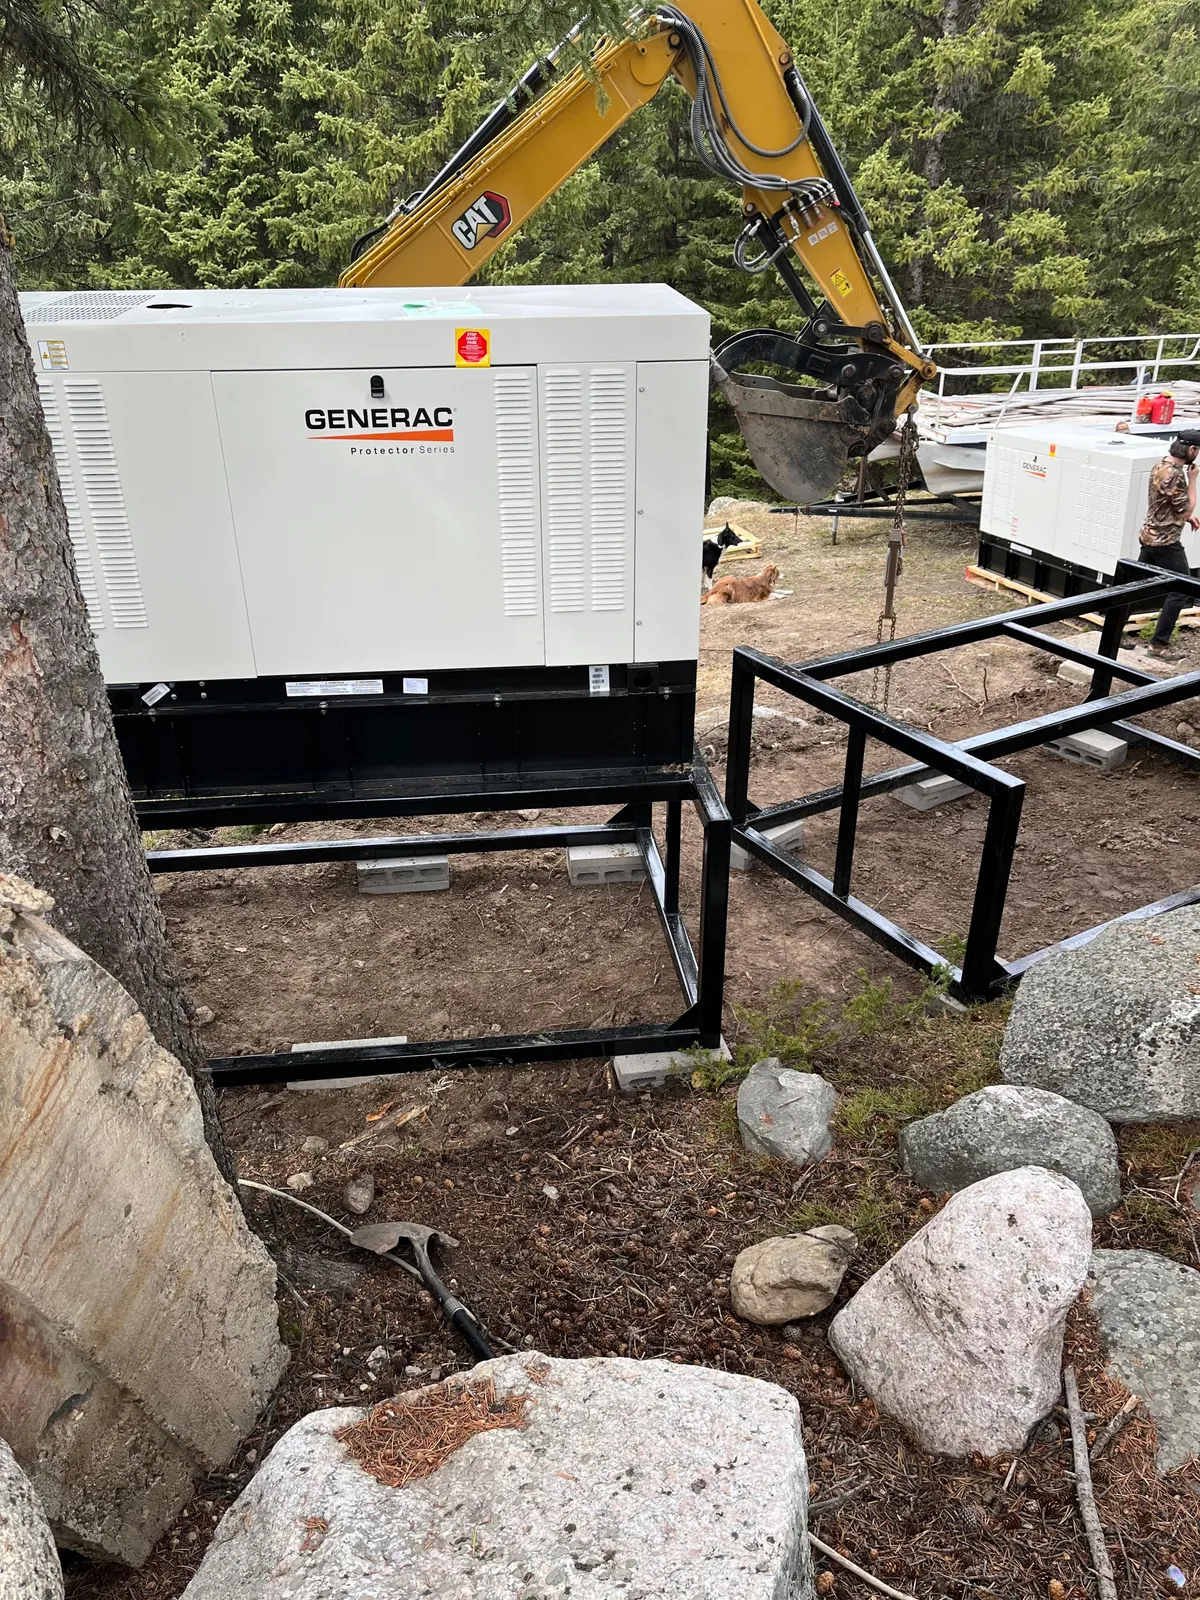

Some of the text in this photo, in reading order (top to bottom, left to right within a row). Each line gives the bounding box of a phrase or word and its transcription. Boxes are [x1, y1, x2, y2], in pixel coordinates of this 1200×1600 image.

[452, 195, 499, 249] CAT
[305, 407, 453, 430] GENERAC
[350, 445, 455, 456] Protector Series
[1022, 462, 1047, 473] GENERAC
